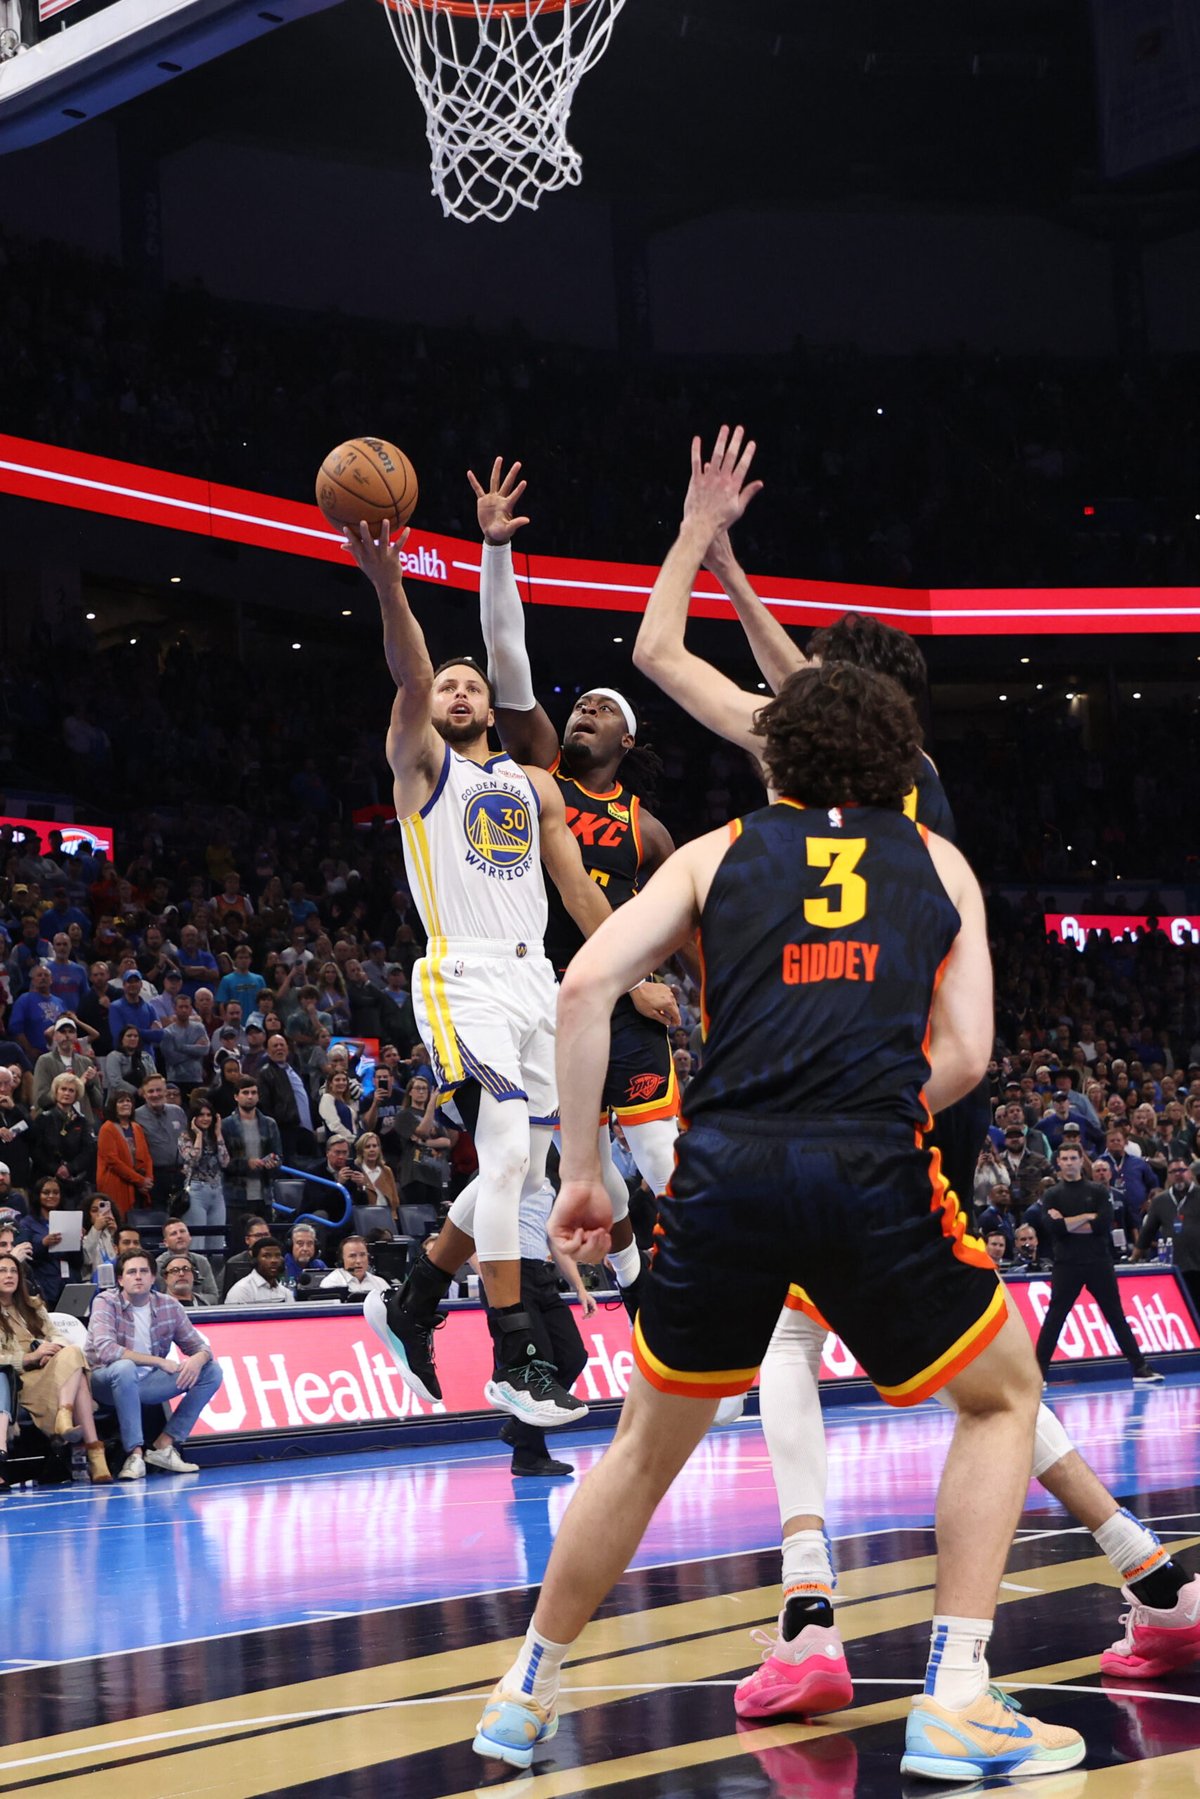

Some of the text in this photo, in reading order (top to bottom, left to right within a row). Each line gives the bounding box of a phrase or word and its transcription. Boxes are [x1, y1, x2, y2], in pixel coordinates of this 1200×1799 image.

[398, 546, 448, 580] ealth
[461, 780, 531, 808] GOLDEN STATE
[500, 808, 525, 831] 30
[464, 849, 533, 881] WARRIORS
[803, 836, 867, 929] 3
[782, 940, 880, 985] GIDDEY
[243, 1340, 447, 1428] Healt
